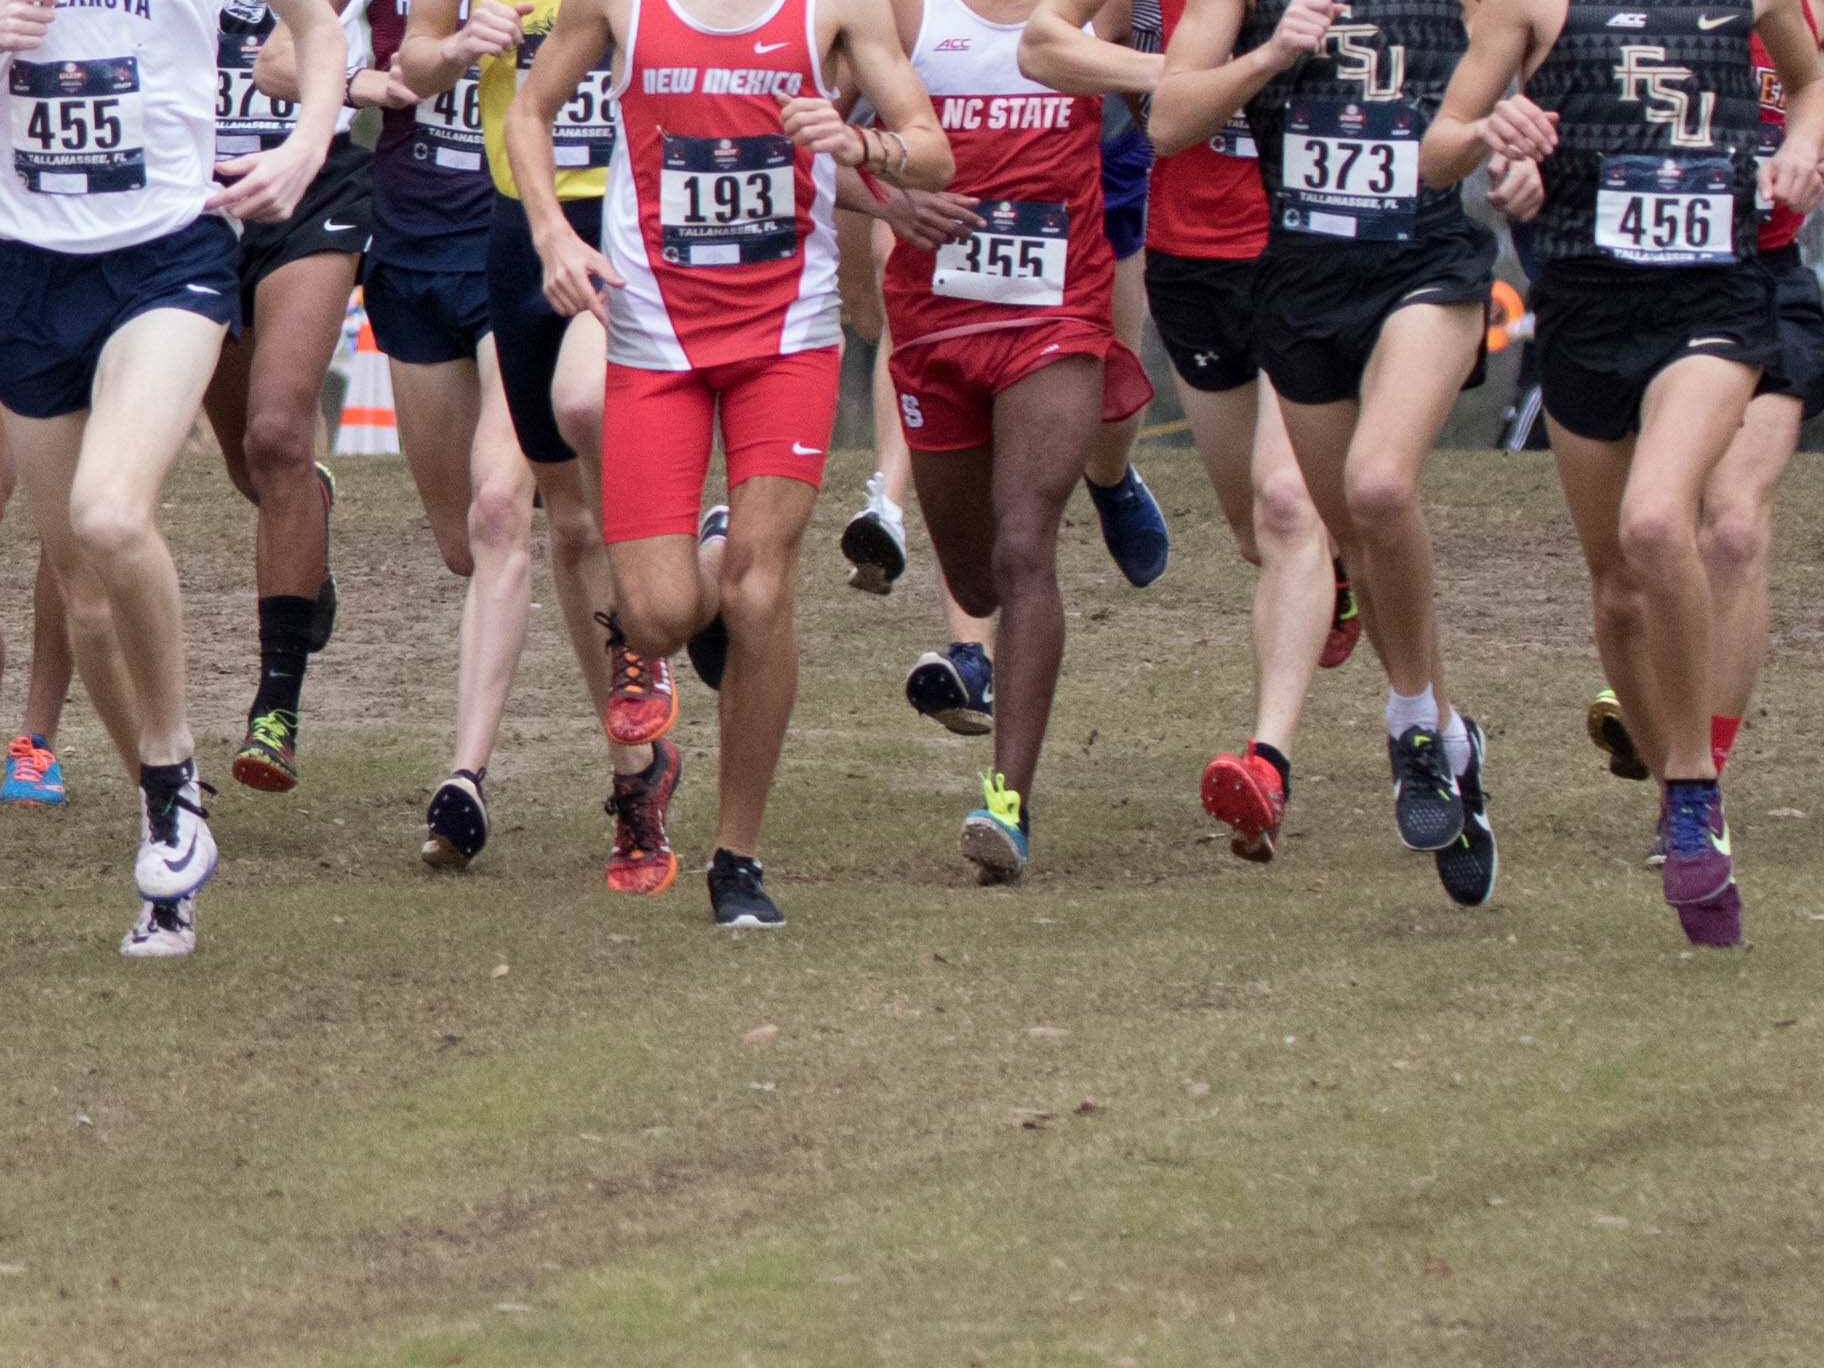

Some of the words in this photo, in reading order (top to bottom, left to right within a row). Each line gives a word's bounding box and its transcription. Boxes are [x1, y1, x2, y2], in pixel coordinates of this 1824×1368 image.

[1606, 12, 1648, 28] ACC
[934, 38, 972, 52] ACC
[642, 67, 698, 95] NEW
[702, 67, 803, 96] MEXICO
[1613, 45, 1717, 148] FSU
[28, 99, 121, 150] 455
[433, 83, 481, 132] 46
[942, 97, 983, 129] NC
[988, 97, 1075, 130] STATE
[28, 154, 110, 165] TALLAHASSEE,
[114, 153, 127, 162] FL
[1304, 140, 1395, 194] 373
[684, 172, 774, 224] 193
[1300, 193, 1381, 210] TALLAHASSEE,
[1383, 198, 1399, 210] FL
[1619, 196, 1712, 248] 456
